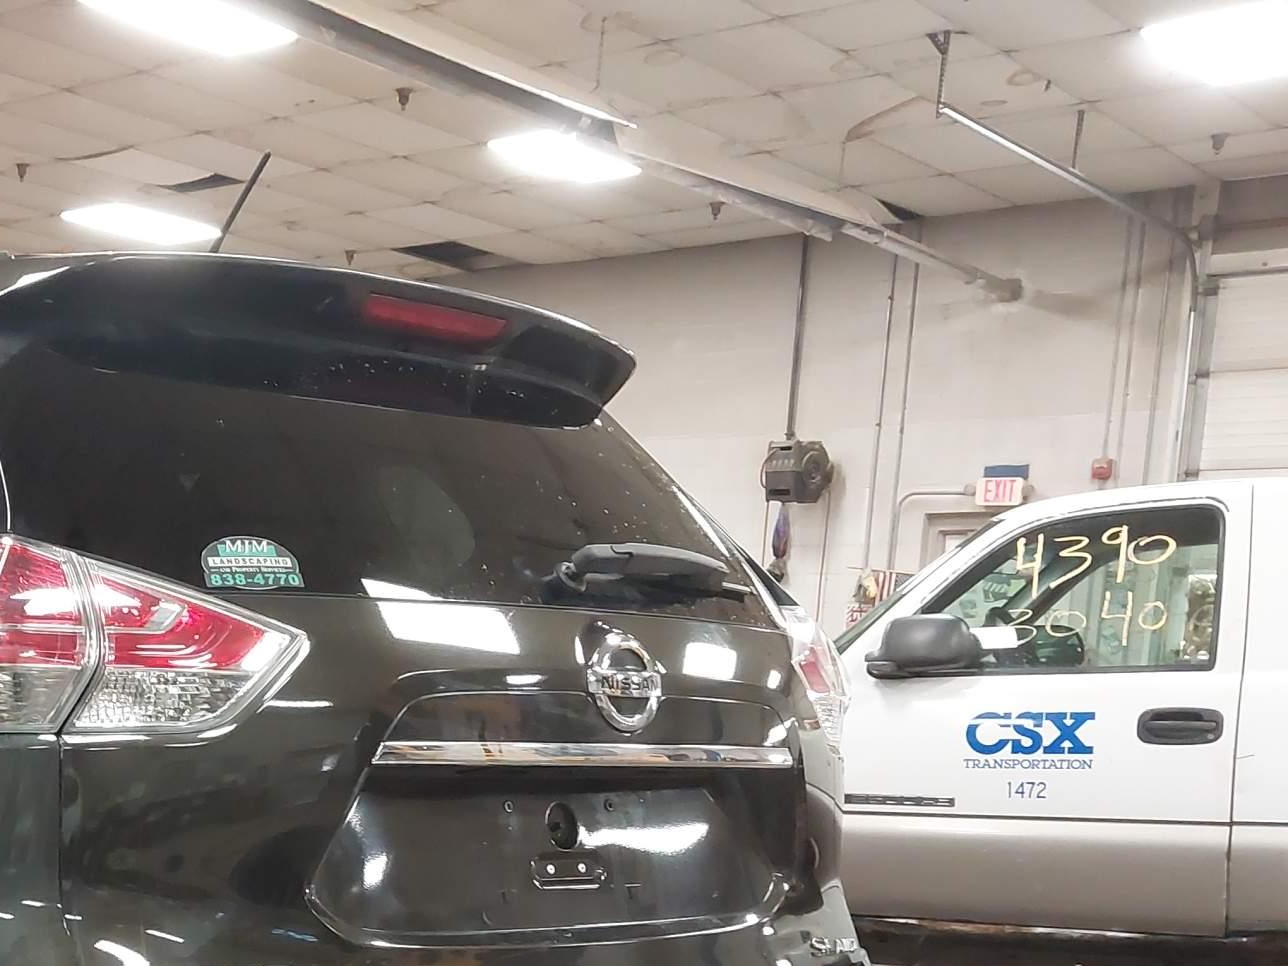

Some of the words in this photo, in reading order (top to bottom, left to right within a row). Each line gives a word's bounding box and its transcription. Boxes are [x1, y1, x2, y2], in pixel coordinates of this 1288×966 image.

[983, 479, 1017, 503] EXIT
[224, 539, 269, 554] MJM
[212, 558, 289, 567] LANDSCAPING
[1016, 525, 1177, 600] 4390
[210, 573, 300, 586] 838-4770
[1006, 590, 1168, 647] 3040
[965, 711, 1095, 755] CSX
[963, 758, 1094, 770] TRANSPORTATION
[1007, 781, 1047, 799] 1472
